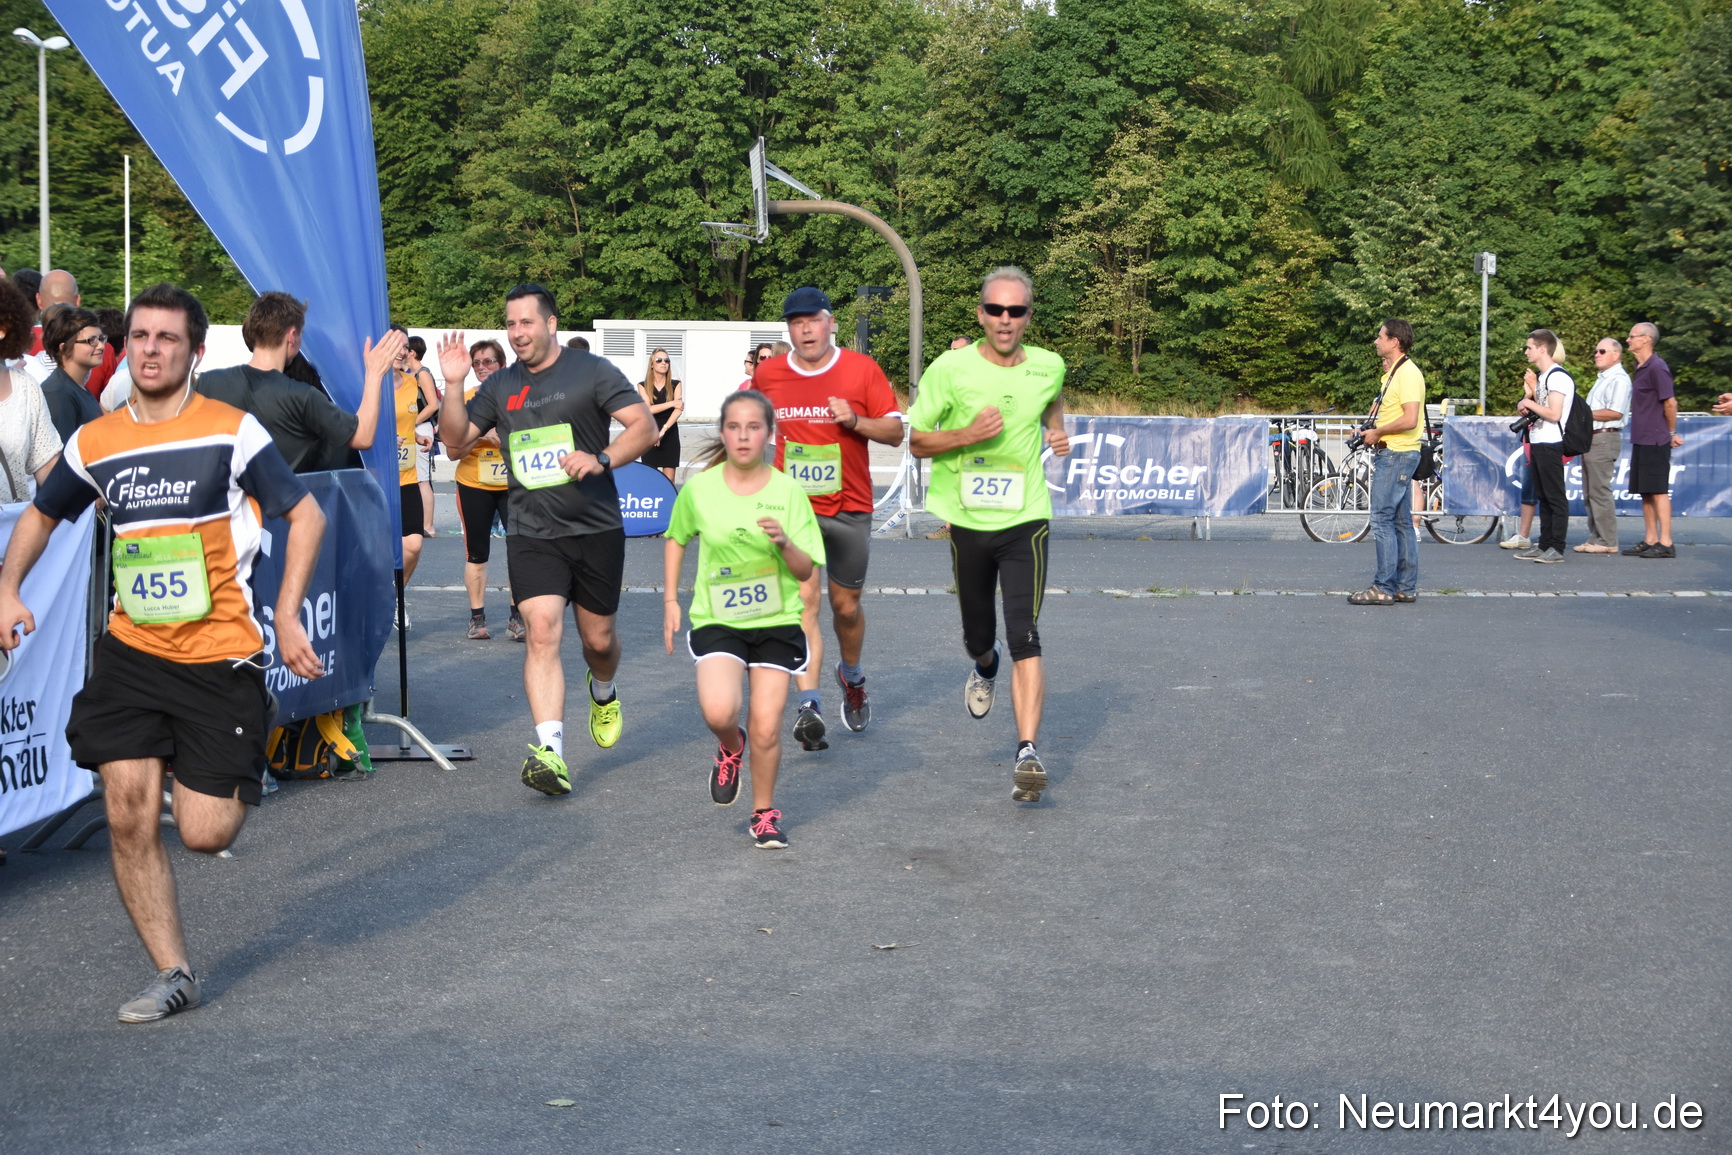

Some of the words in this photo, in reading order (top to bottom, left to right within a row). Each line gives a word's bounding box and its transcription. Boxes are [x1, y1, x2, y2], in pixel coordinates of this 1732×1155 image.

[774, 406, 836, 419] NEUMARK
[789, 463, 836, 482] 1402
[1067, 458, 1208, 485] Fischer
[119, 478, 197, 501] Fischer
[972, 477, 1013, 496] 257
[1079, 488, 1196, 501] AUTOMOBILE
[125, 495, 190, 510] AUTOMOBILE
[619, 493, 663, 509] cher
[131, 570, 188, 600] 455
[722, 584, 768, 608] 258
[1, 696, 37, 735] kter
